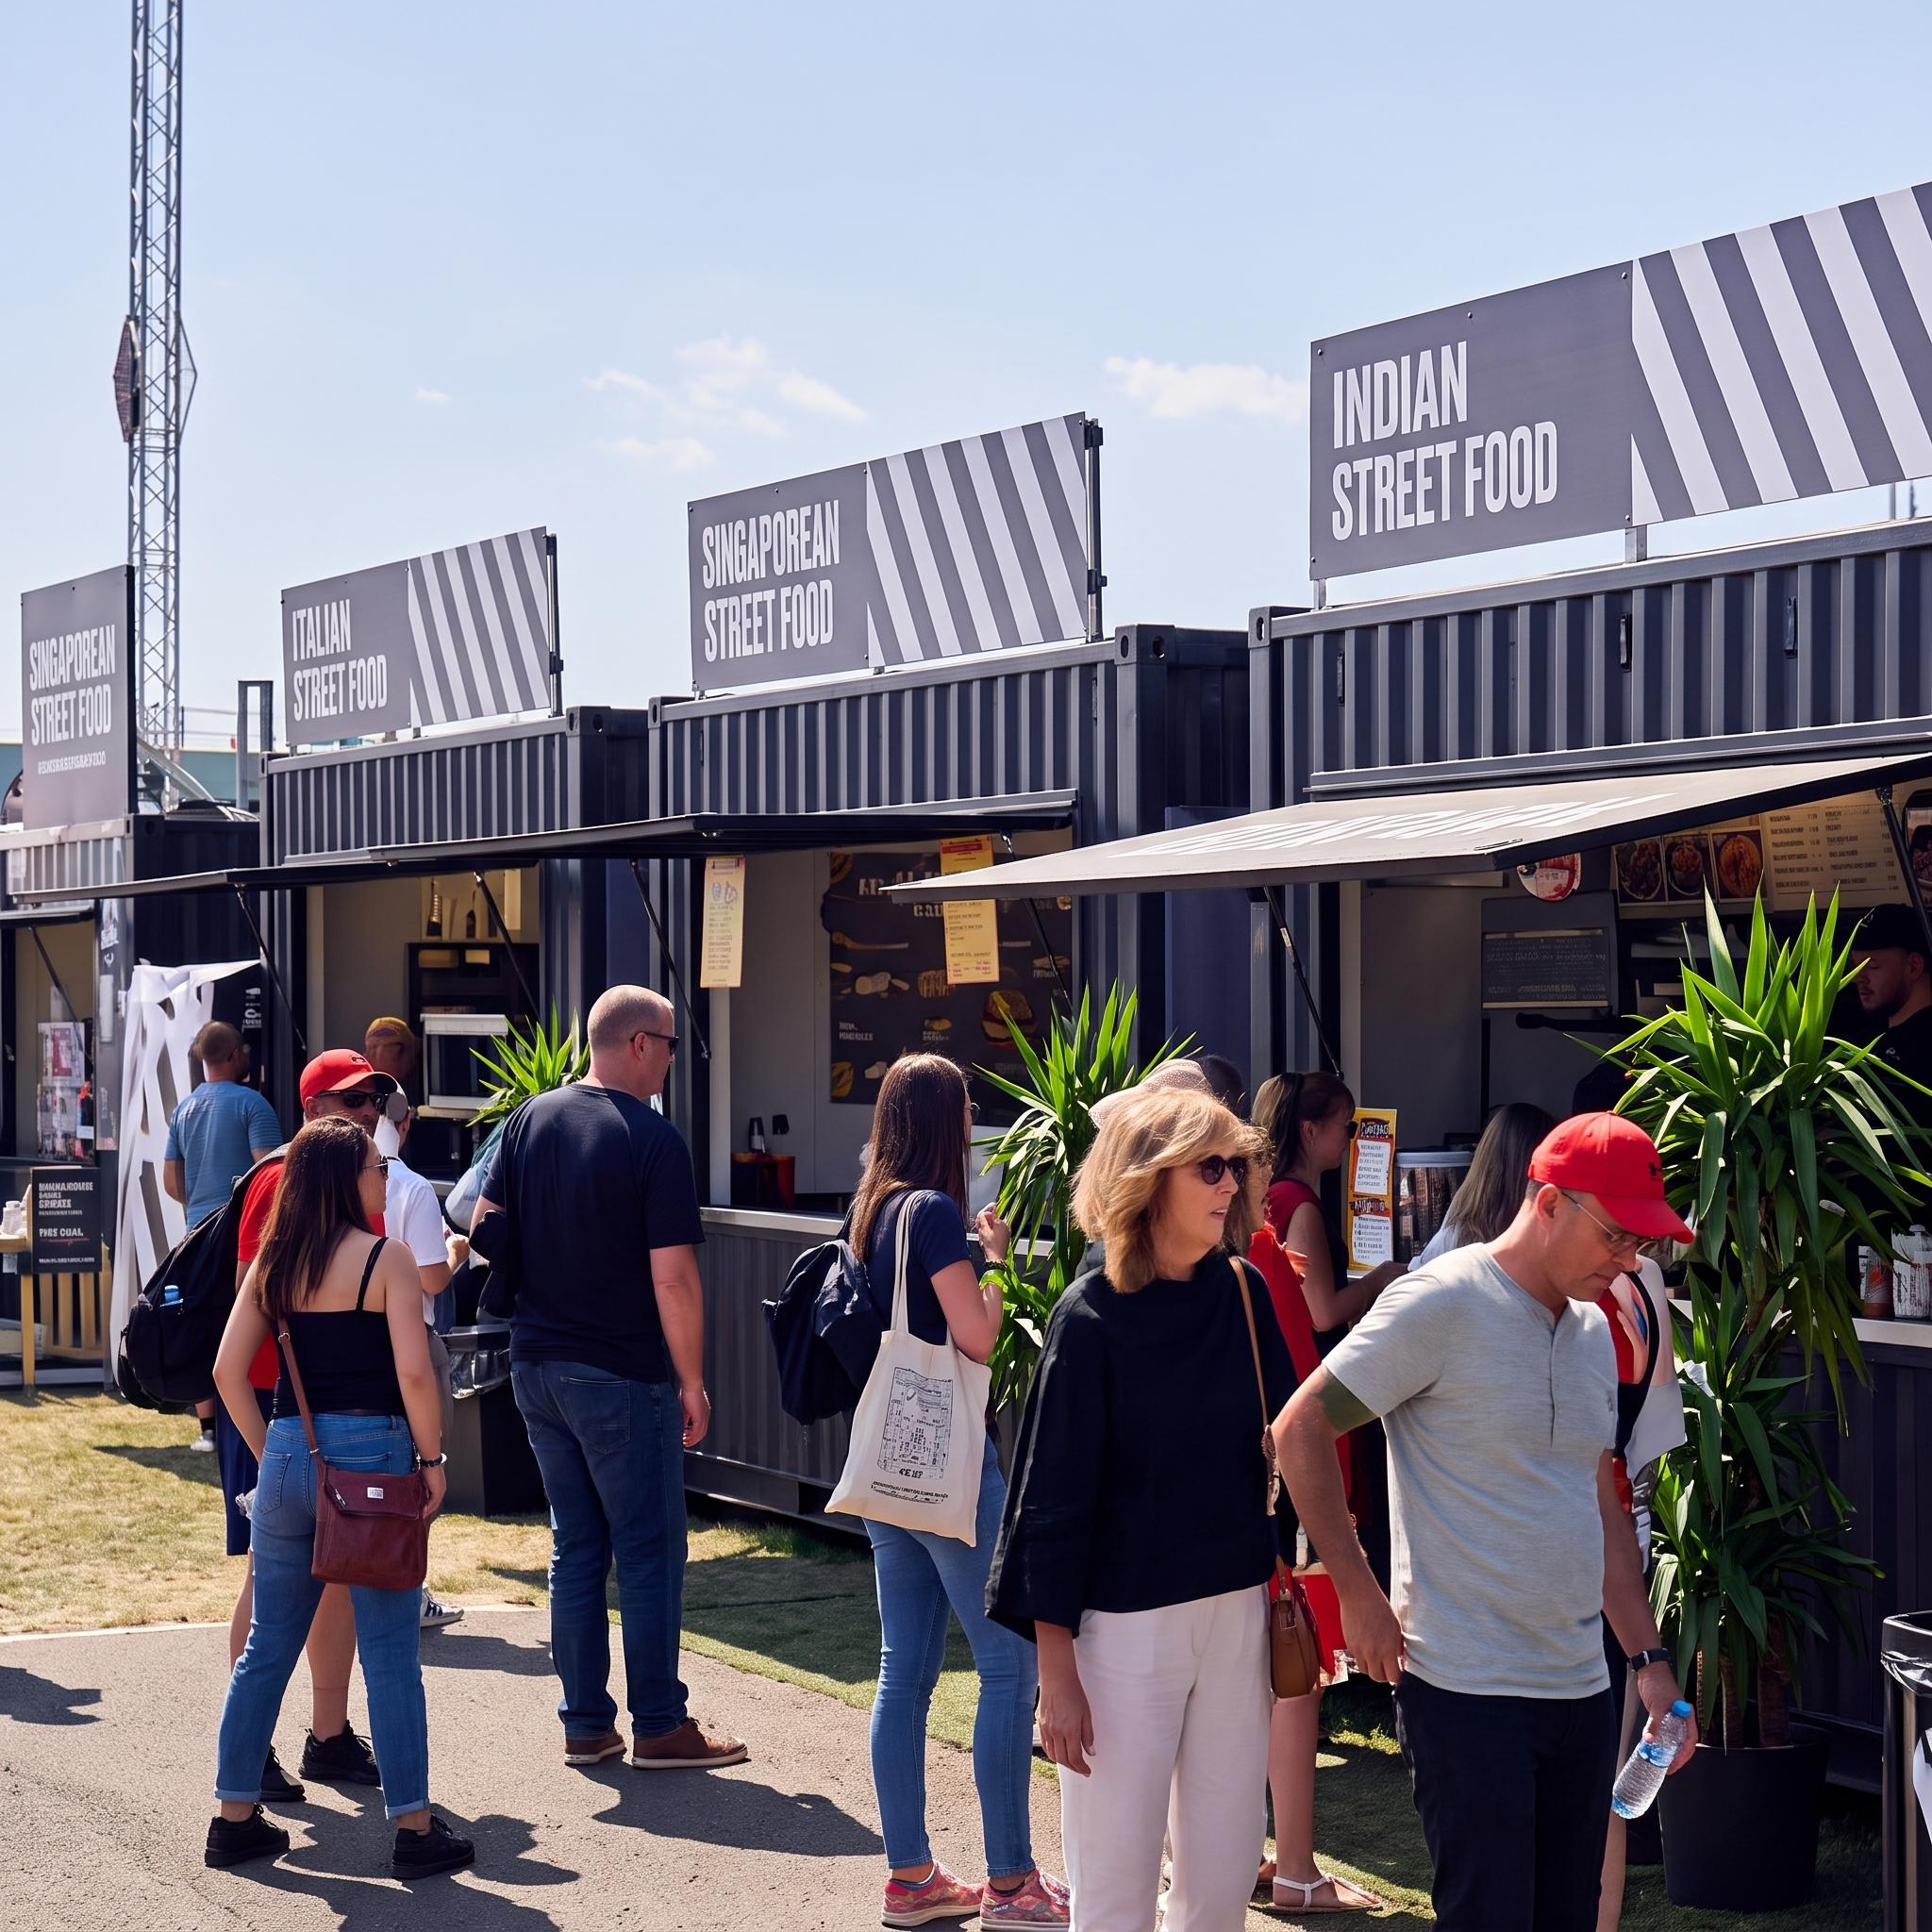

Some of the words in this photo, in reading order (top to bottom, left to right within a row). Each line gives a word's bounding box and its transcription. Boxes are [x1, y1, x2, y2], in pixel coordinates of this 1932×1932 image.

[1332, 340, 1469, 449] INDIAN
[1332, 440, 1458, 541] STREET
[1464, 421, 1558, 519] FOOD
[701, 499, 841, 590] SINGAPOREAN
[29, 624, 116, 691] SINGAPOREAN
[292, 598, 352, 662] ITALIAN
[703, 589, 775, 662] STREET
[780, 579, 834, 651] FOOD
[30, 690, 76, 746] STREET
[78, 684, 112, 737] FOOD
[293, 661, 346, 723] STREET
[348, 654, 389, 714] FOOD
